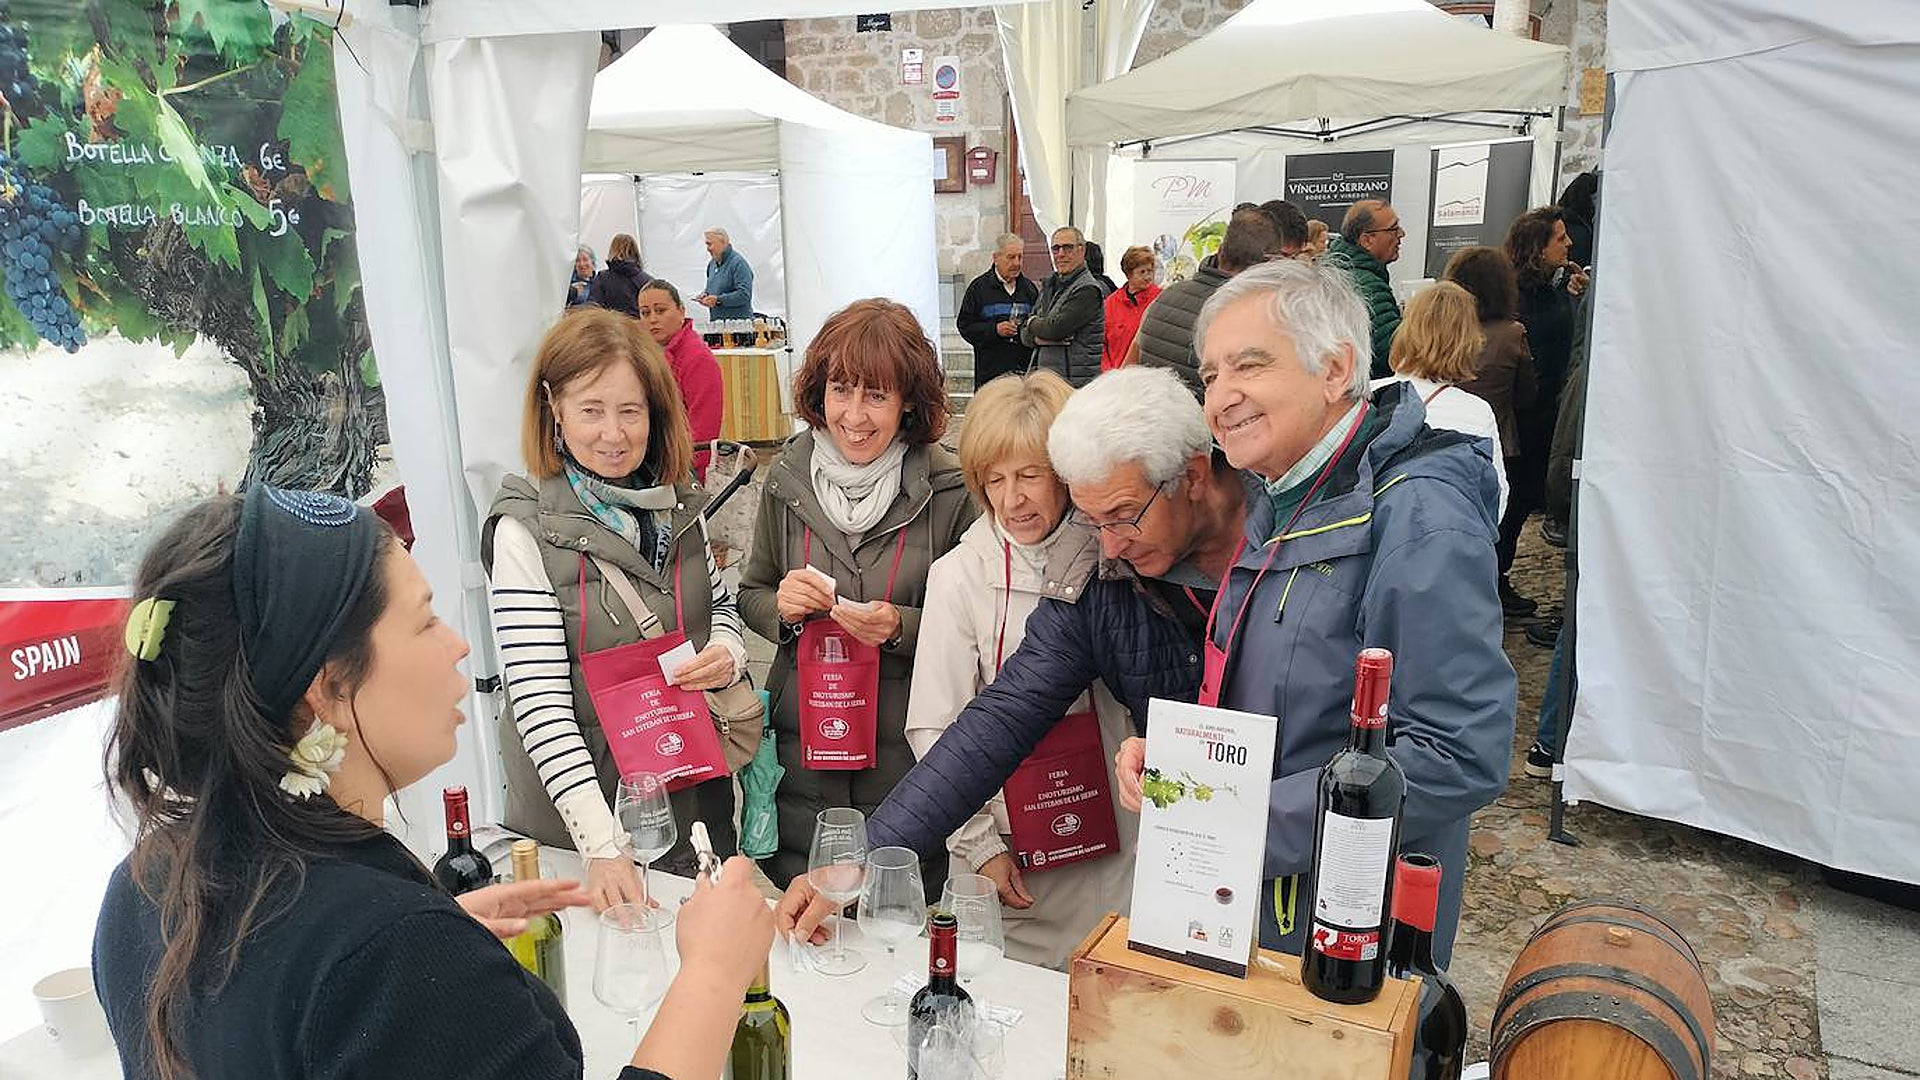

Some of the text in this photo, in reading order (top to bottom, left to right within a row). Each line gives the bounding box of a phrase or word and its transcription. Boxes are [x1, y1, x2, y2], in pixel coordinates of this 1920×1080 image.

[65, 131, 286, 170] BOTELLA CNZA 6€
[1340, 181, 1389, 192] SERRANO
[78, 199, 157, 226] BOTELLA
[170, 202, 244, 229] BLANCO
[11, 636, 80, 680] SPAIN
[1206, 741, 1247, 766] TORO
[1342, 934, 1370, 944] TORO
